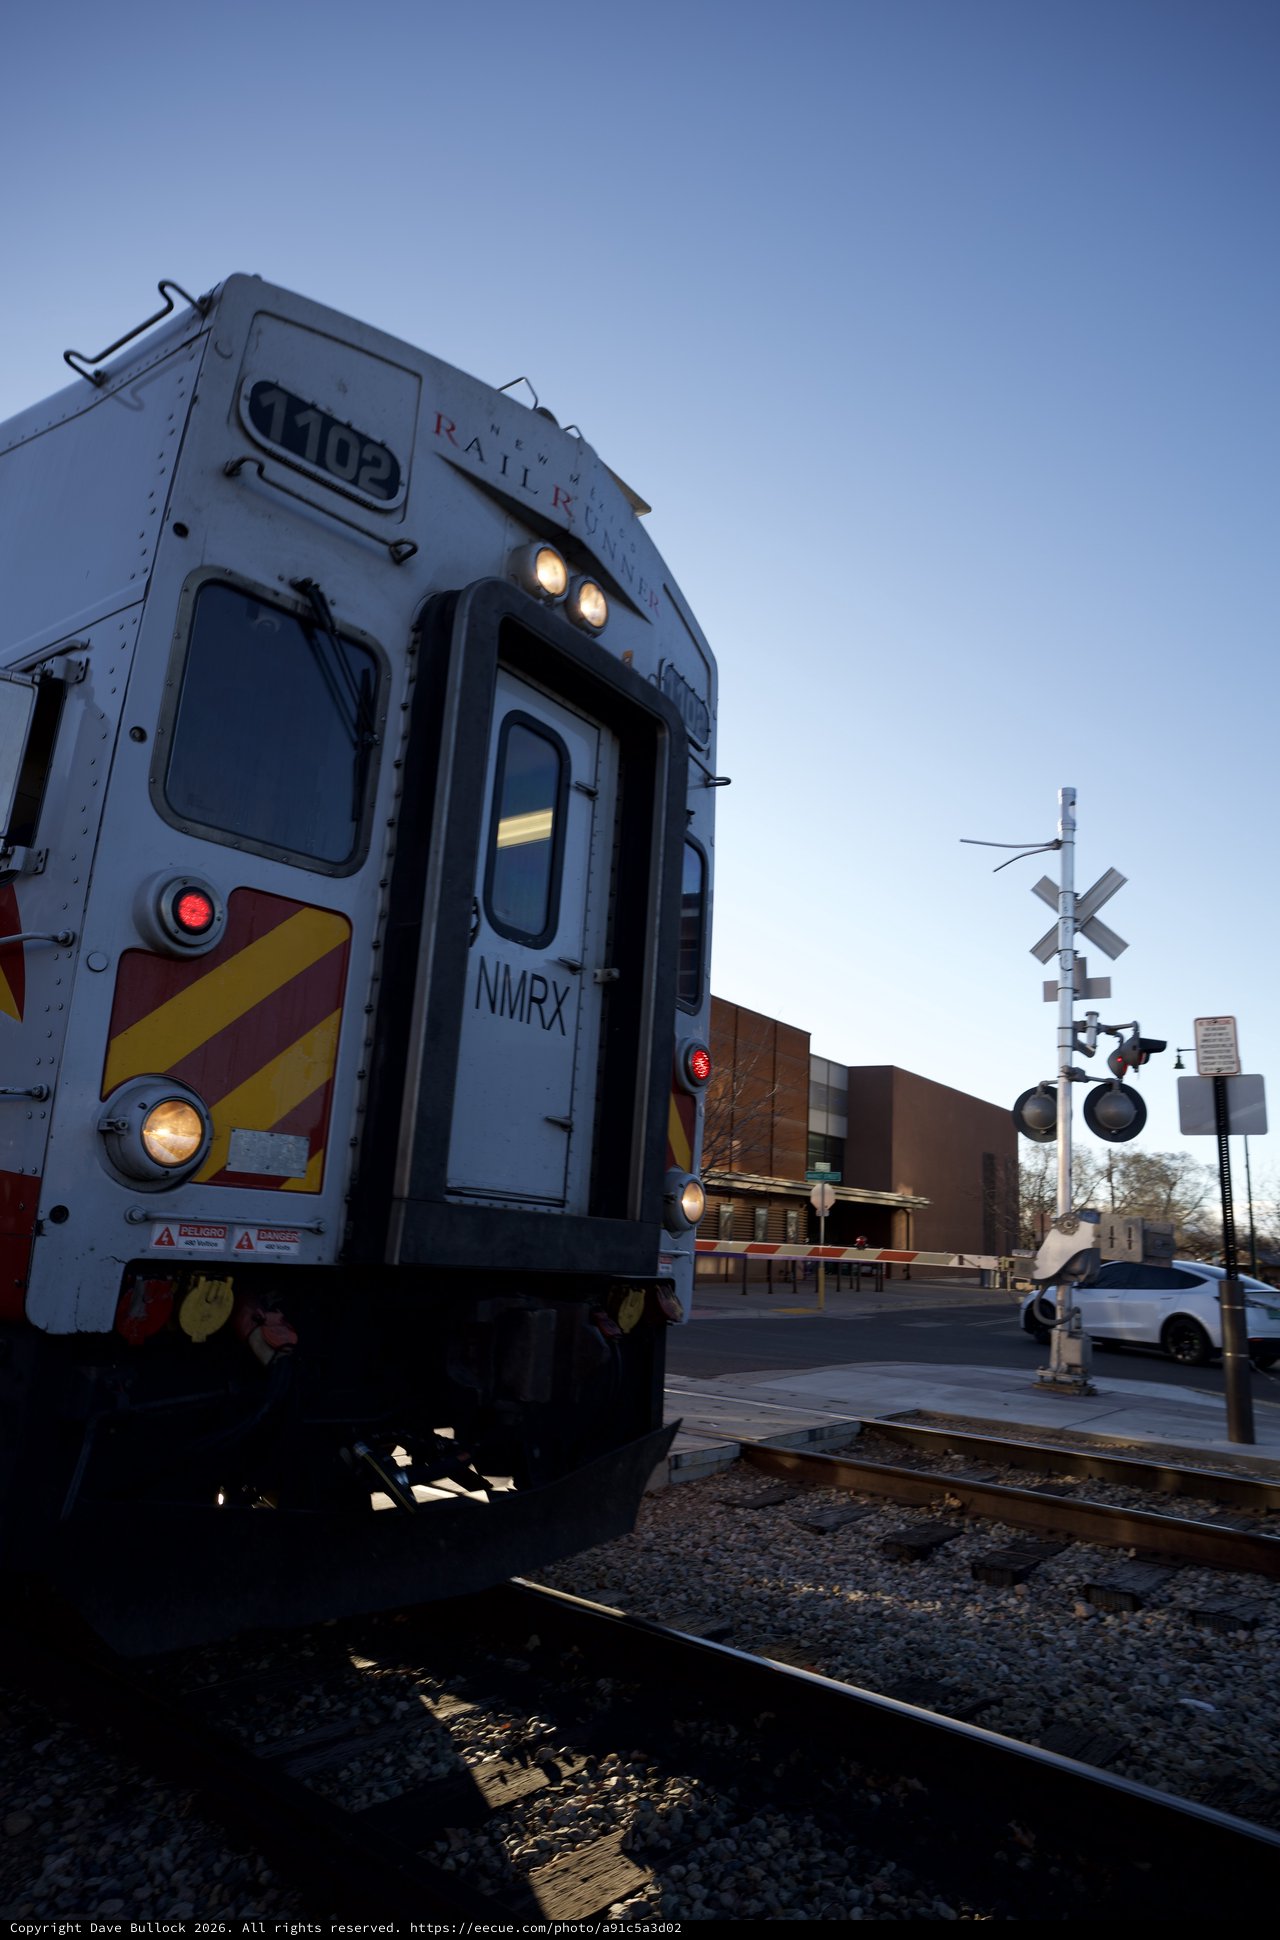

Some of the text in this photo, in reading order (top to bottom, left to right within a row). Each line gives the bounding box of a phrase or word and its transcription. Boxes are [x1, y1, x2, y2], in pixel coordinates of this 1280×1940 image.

[257, 387, 392, 500] 1102
[490, 422, 549, 466] NEW
[475, 955, 570, 1037] NMRX
[181, 1226, 225, 1238] PELIGRO
[259, 1230, 299, 1241] DANGER
